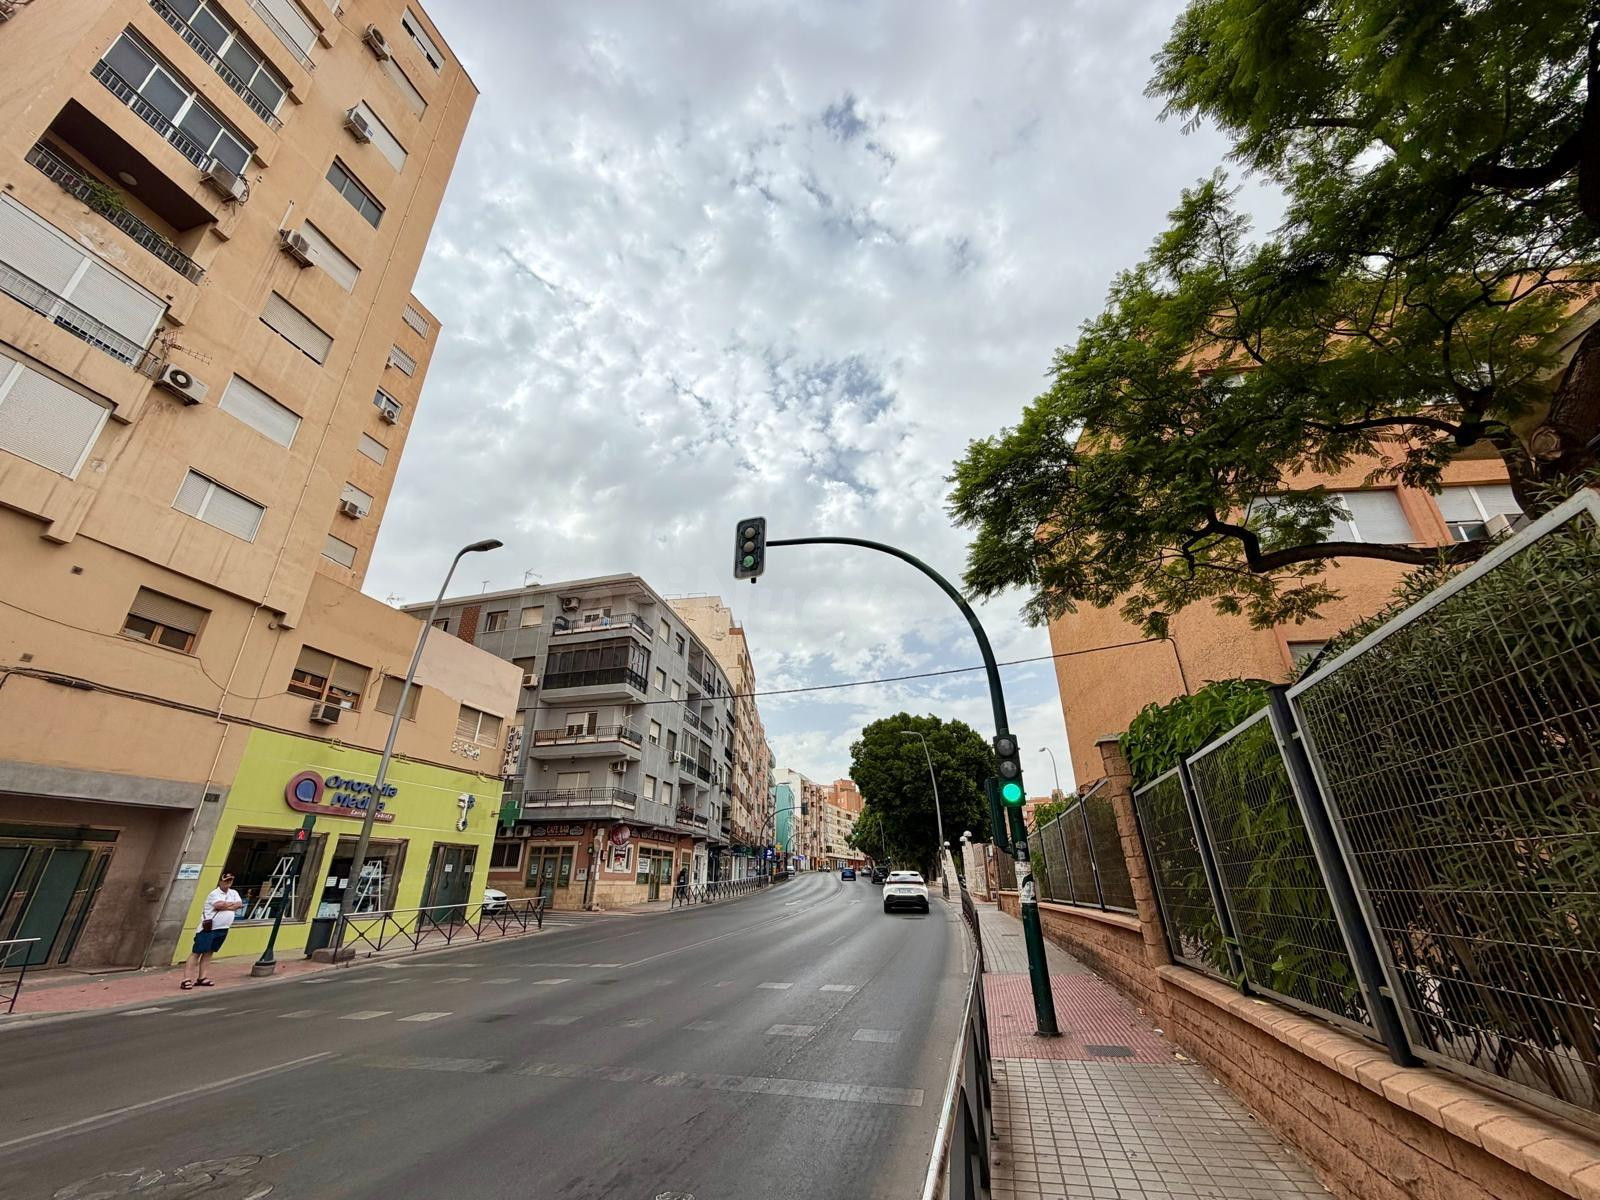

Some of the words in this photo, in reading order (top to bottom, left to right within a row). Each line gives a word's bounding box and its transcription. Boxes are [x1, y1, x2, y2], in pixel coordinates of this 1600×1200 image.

[503, 727, 516, 774] HOSTAL
[512, 732, 522, 764] LUZ
[331, 792, 385, 811] Média
